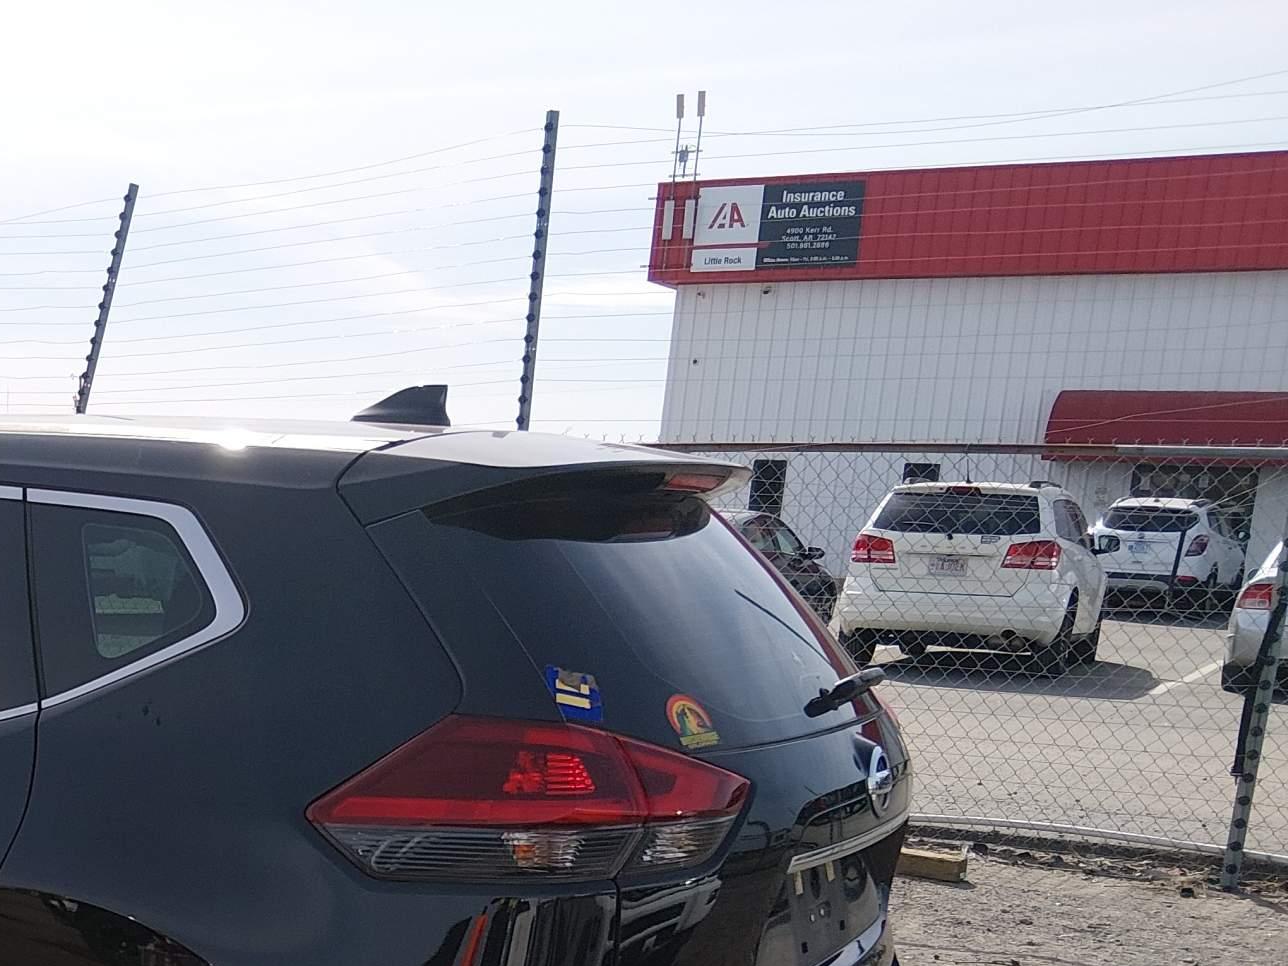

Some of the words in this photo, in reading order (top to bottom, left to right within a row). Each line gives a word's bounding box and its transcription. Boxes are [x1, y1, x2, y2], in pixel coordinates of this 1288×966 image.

[782, 190, 845, 203] Insurance
[768, 206, 797, 219] Auto
[799, 203, 856, 217] Auctions
[786, 226, 803, 235] 4900
[805, 226, 820, 234] Kerr
[822, 225, 834, 233] Rd.
[704, 257, 722, 265] Little
[724, 256, 742, 265] Rock
